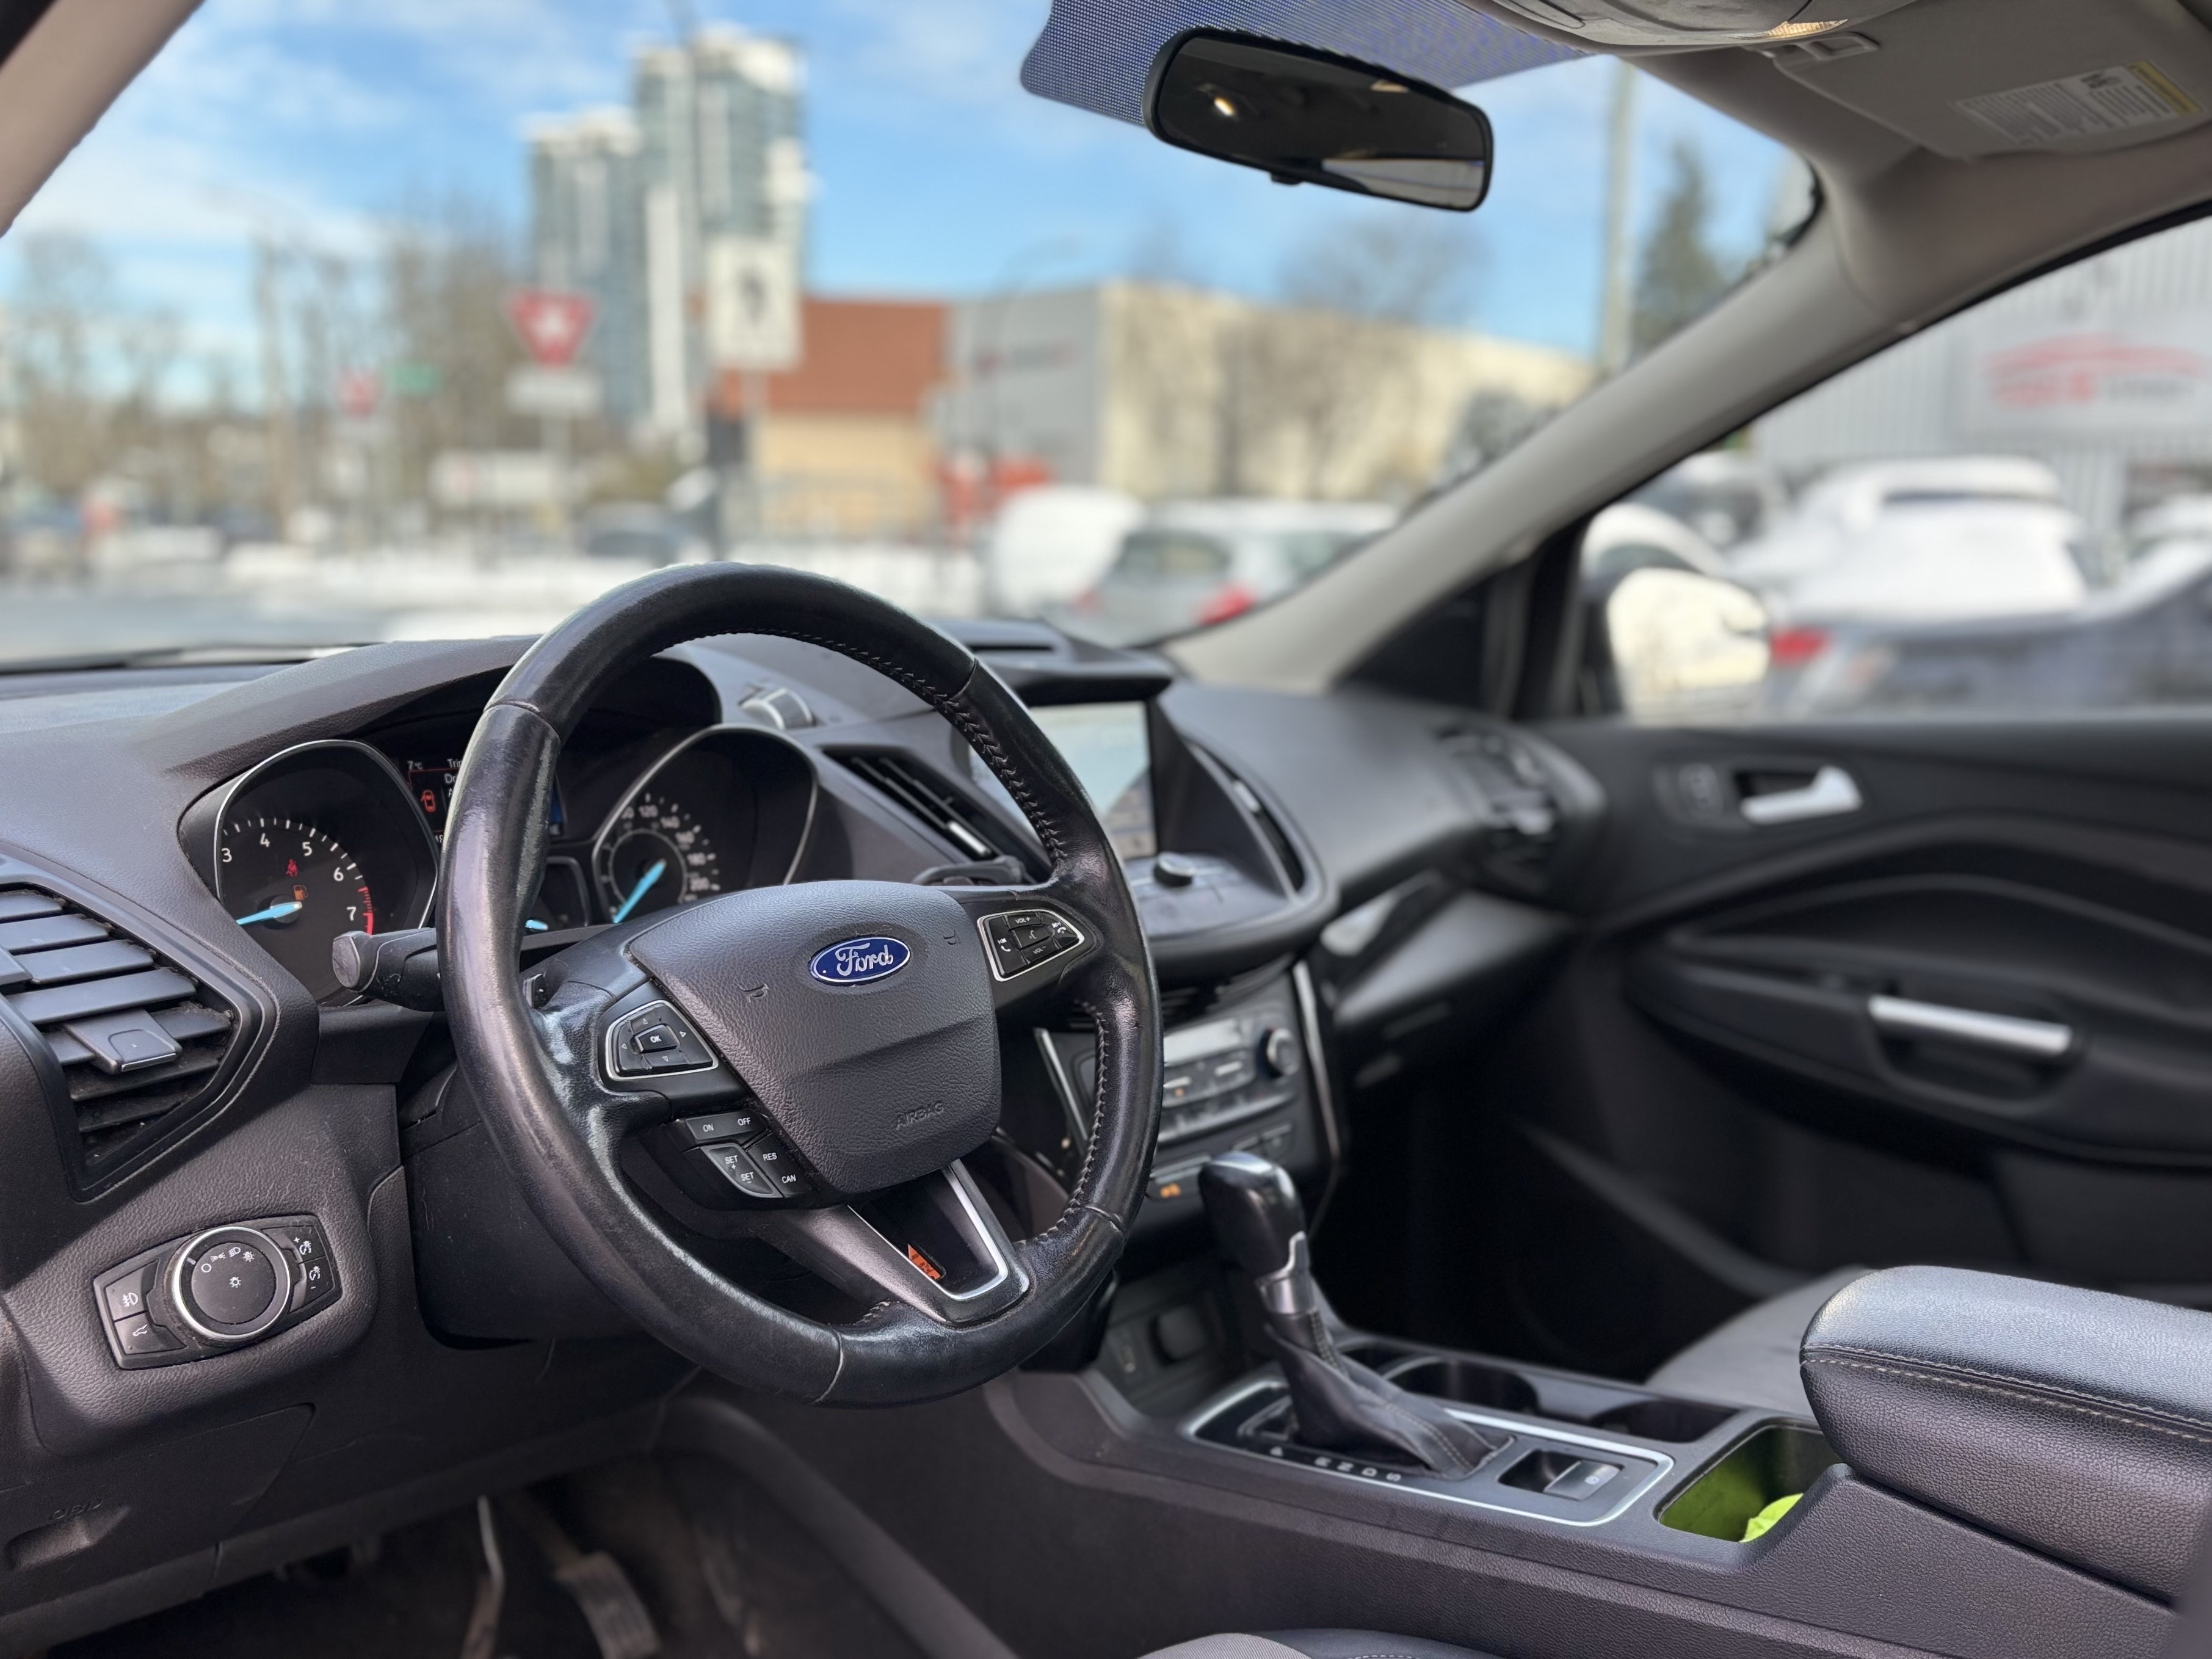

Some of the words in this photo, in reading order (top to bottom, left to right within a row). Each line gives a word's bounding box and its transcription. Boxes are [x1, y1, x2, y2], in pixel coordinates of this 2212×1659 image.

[259, 833, 270, 847] 4
[221, 848, 232, 862] 3
[302, 841, 313, 856] 5
[333, 867, 344, 881] 6
[346, 906, 357, 921] 7
[835, 942, 893, 976] Ford
[703, 1124, 714, 1132] ON
[738, 1117, 751, 1126] OFF
[725, 1155, 738, 1164] SET
[763, 1152, 777, 1161] RES
[741, 1172, 754, 1182] SET
[781, 1174, 796, 1183] CAN
[1362, 1467, 1377, 1477] D
[1386, 1472, 1402, 1482] S
